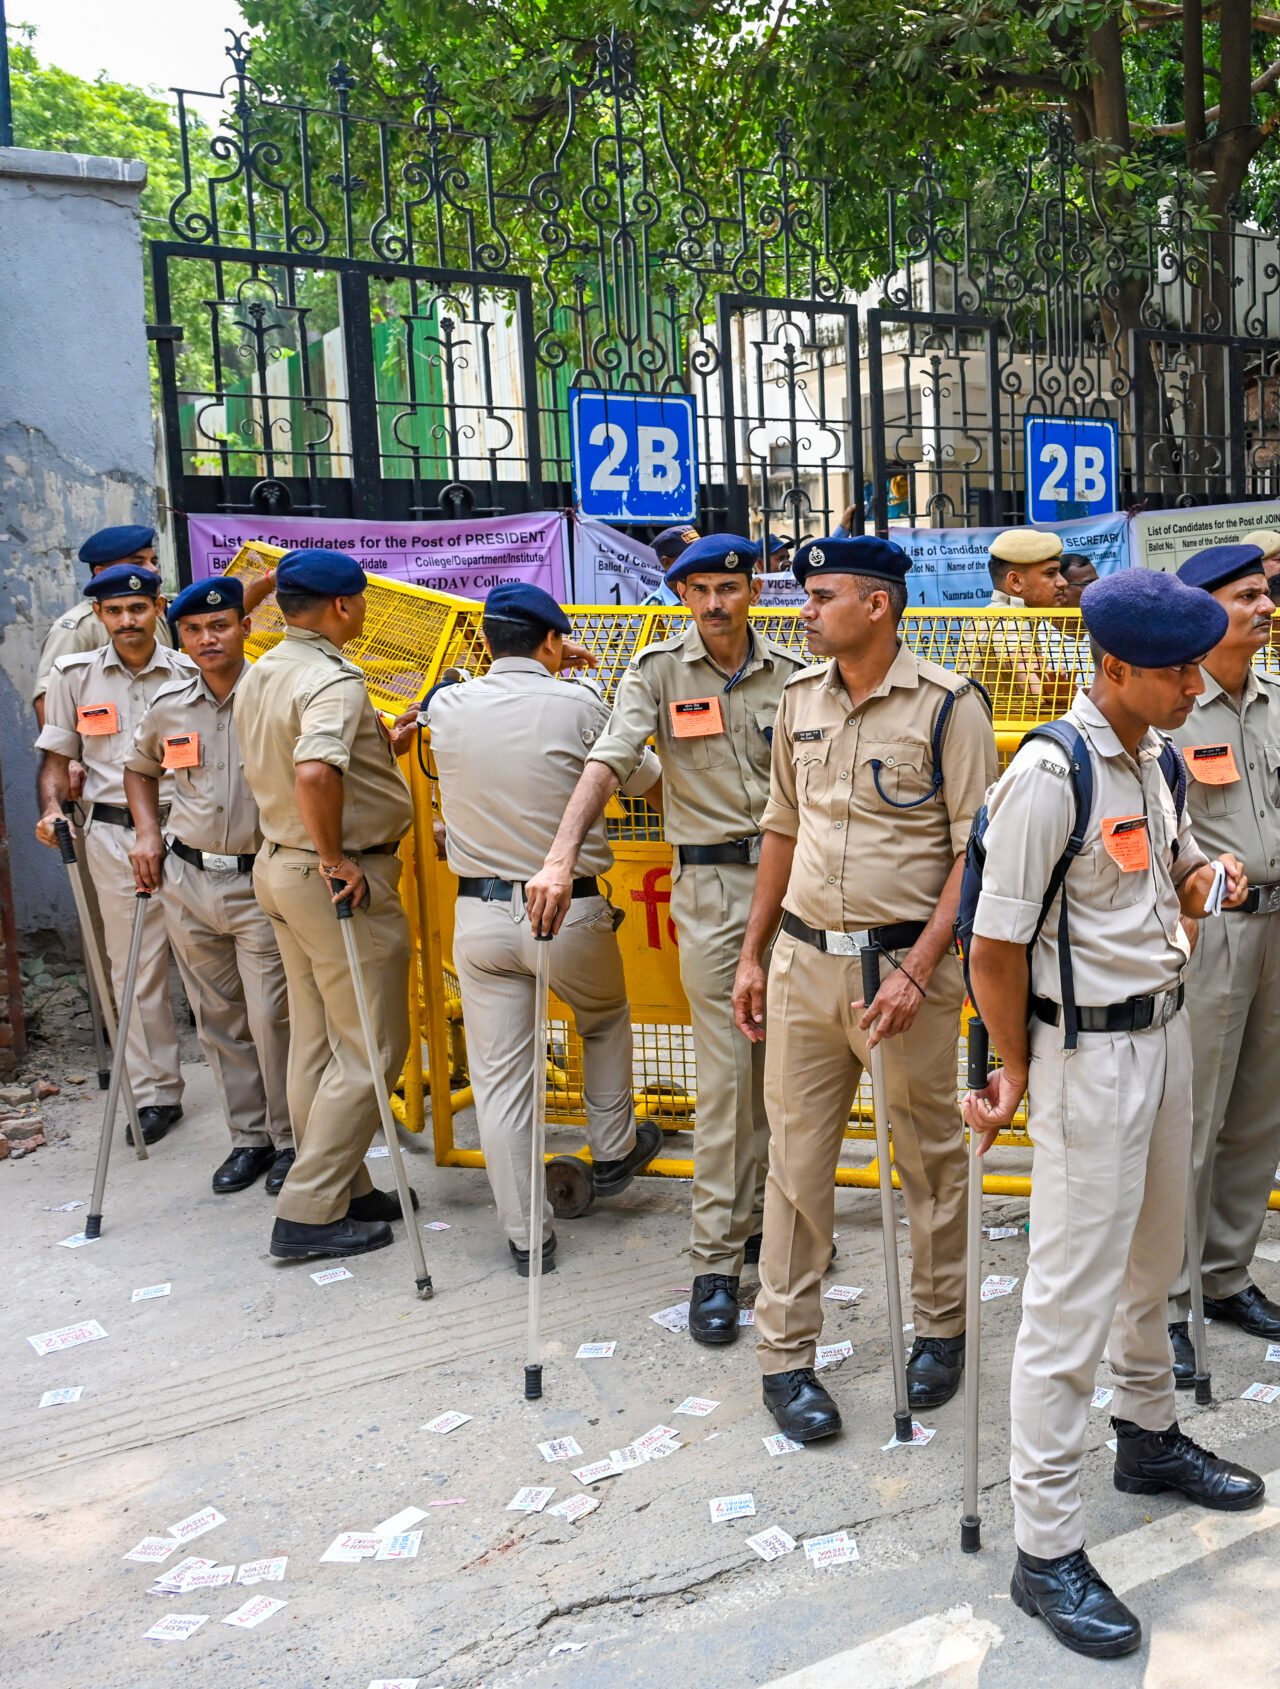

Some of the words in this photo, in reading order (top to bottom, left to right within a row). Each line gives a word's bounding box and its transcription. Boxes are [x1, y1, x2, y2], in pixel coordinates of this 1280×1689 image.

[589, 422, 681, 492] 2B
[1039, 443, 1106, 502] 2B
[1147, 526, 1162, 537] List
[1163, 525, 1171, 534] of
[1172, 521, 1213, 534] Candidates
[1214, 520, 1225, 530] for
[1226, 518, 1238, 528] the
[1239, 517, 1255, 527] Post
[1256, 515, 1263, 525] of
[212, 535, 242, 548] List
[268, 535, 355, 549] Candidates
[360, 536, 381, 549] for
[385, 536, 407, 548] the
[412, 535, 443, 548] Post
[447, 534, 462, 546] of
[465, 531, 546, 546] PRESIDENT
[1148, 542, 1165, 551] Ballot
[1165, 540, 1175, 550] No.
[1182, 539, 1197, 548] Name
[1198, 537, 1204, 547] of
[1205, 536, 1214, 546] the
[1214, 535, 1239, 545] Candidate
[926, 545, 937, 556] of
[940, 544, 989, 555] Candidate
[359, 558, 387, 570] didate
[415, 552, 543, 568] College/Department/Institute
[617, 552, 630, 563] of
[598, 560, 621, 572] Ballot
[907, 563, 923, 573] allot
[925, 562, 937, 572] No.
[947, 562, 966, 572] Name
[967, 561, 976, 570] of
[976, 561, 986, 570] the
[416, 576, 469, 590] PGDAV
[768, 579, 804, 589] VICE-P
[609, 583, 621, 605] 1
[919, 591, 926, 605] 1
[942, 590, 974, 601] Namrata
[177, 1516, 205, 1532] YASH
[818, 1547, 845, 1555] YASH
[243, 1564, 271, 1574] YASH
[191, 1574, 219, 1582] YASH
